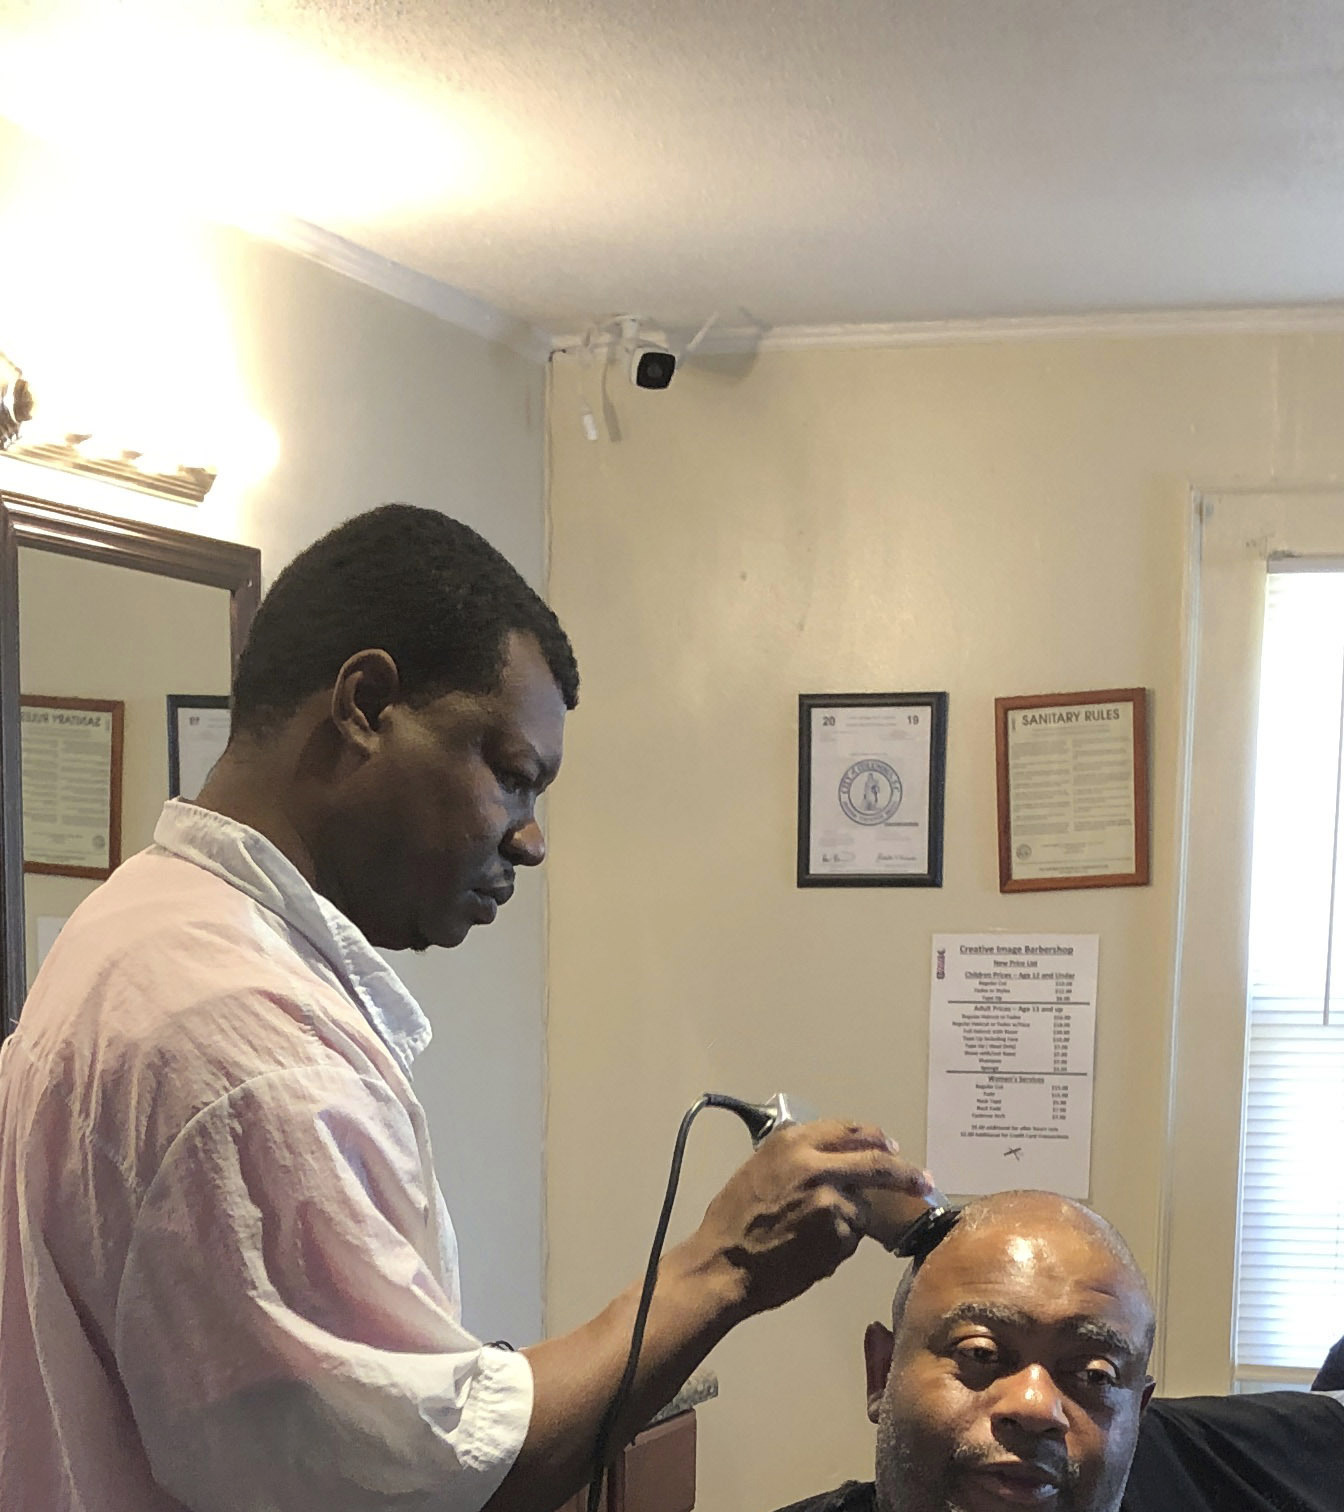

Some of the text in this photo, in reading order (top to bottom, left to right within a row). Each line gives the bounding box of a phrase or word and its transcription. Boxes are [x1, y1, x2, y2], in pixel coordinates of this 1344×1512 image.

[822, 716, 836, 727] 20
[907, 715, 919, 726] 19
[1021, 708, 1120, 726] SANITARY RULES
[959, 945, 1074, 955] Creative Image Barbershop
[965, 971, 992, 979] Children
[1018, 972, 1031, 980] Age
[1018, 1005, 1030, 1013] Age
